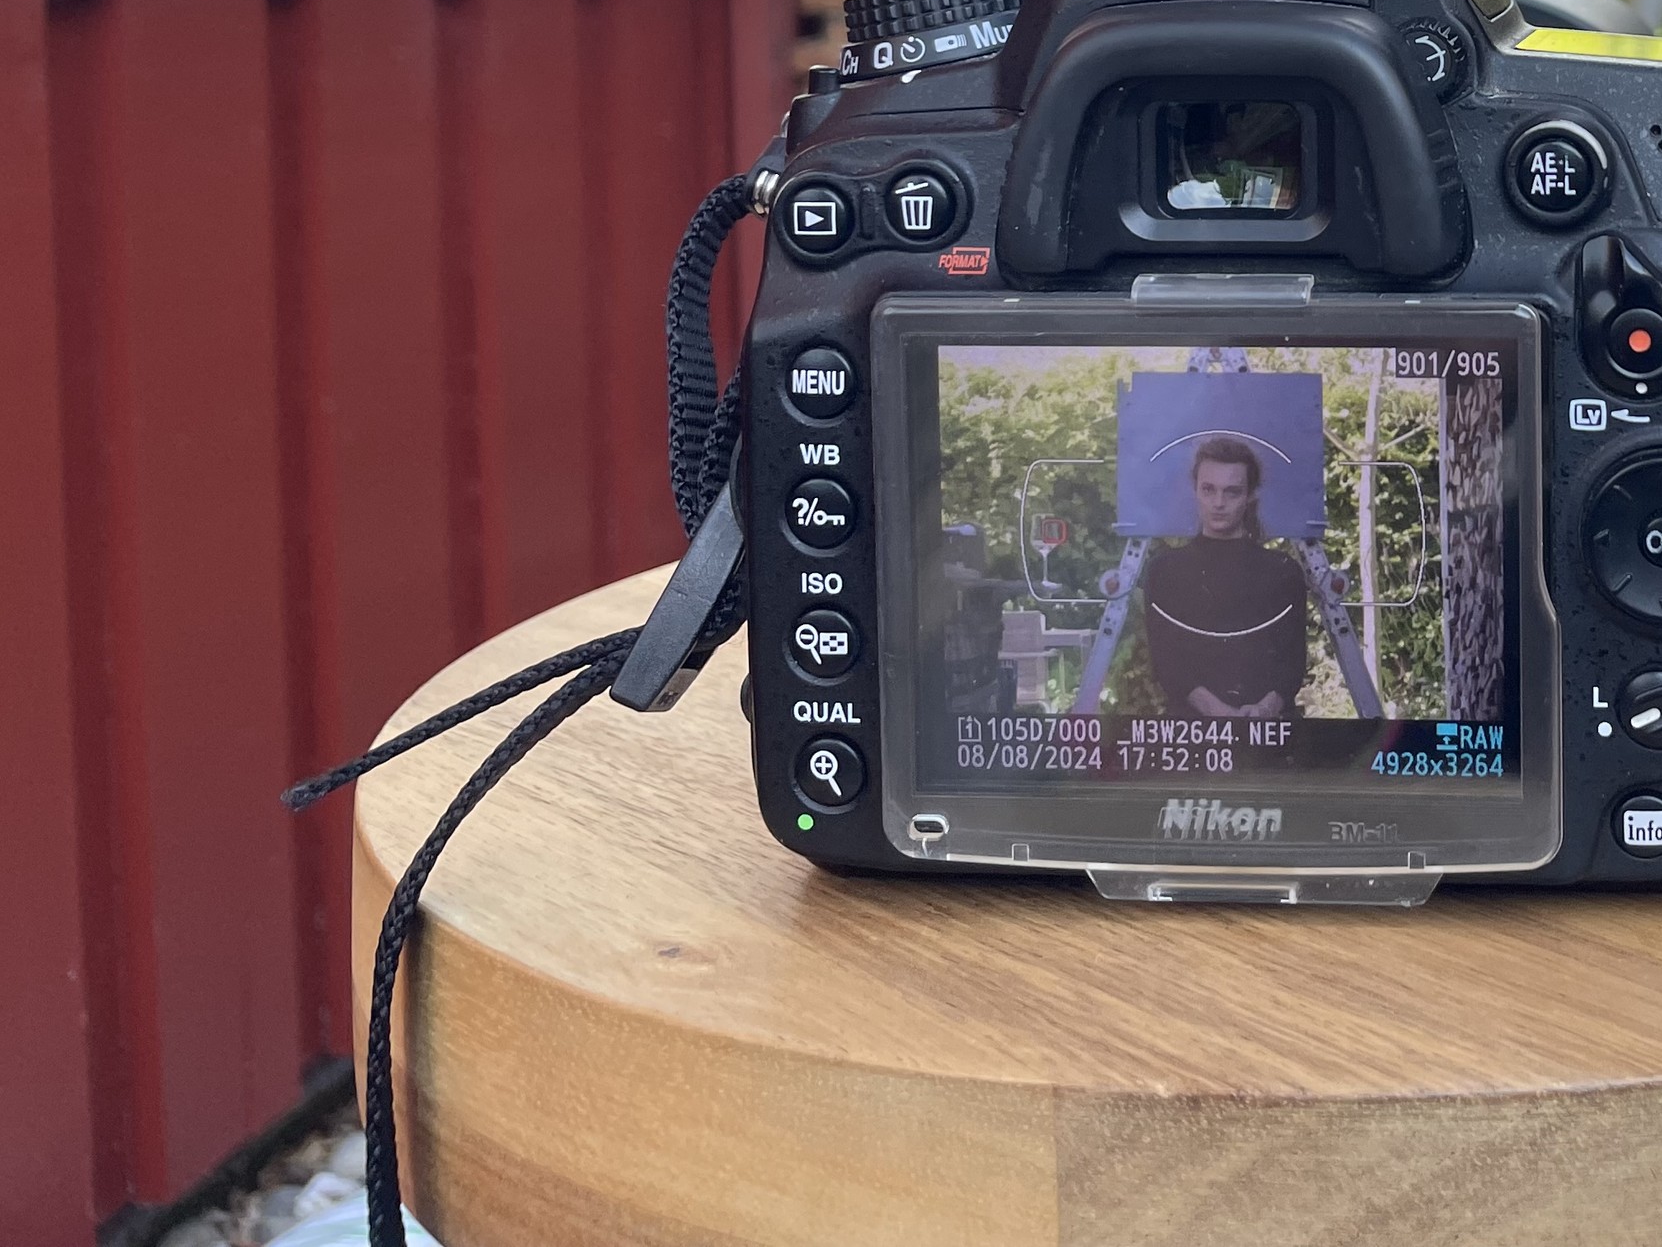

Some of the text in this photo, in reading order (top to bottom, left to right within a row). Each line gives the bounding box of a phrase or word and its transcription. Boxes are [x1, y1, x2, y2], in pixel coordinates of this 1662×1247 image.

[873, 41, 895, 70] Q
[1530, 173, 1577, 196] AF-L
[938, 253, 982, 269] FORMAT
[1396, 349, 1501, 378] 901/905
[791, 368, 846, 396] MENU
[799, 442, 841, 466] WB
[800, 571, 844, 595] ISO
[1592, 686, 1609, 709] L
[792, 699, 862, 724] QUAL
[986, 716, 1101, 743] 105D7000
[1459, 724, 1504, 751] RAW
[956, 741, 1234, 772] 08/08/2024 17:52:08
[1370, 750, 1504, 778] 4928x3264
[1160, 797, 1283, 836] Nikon
